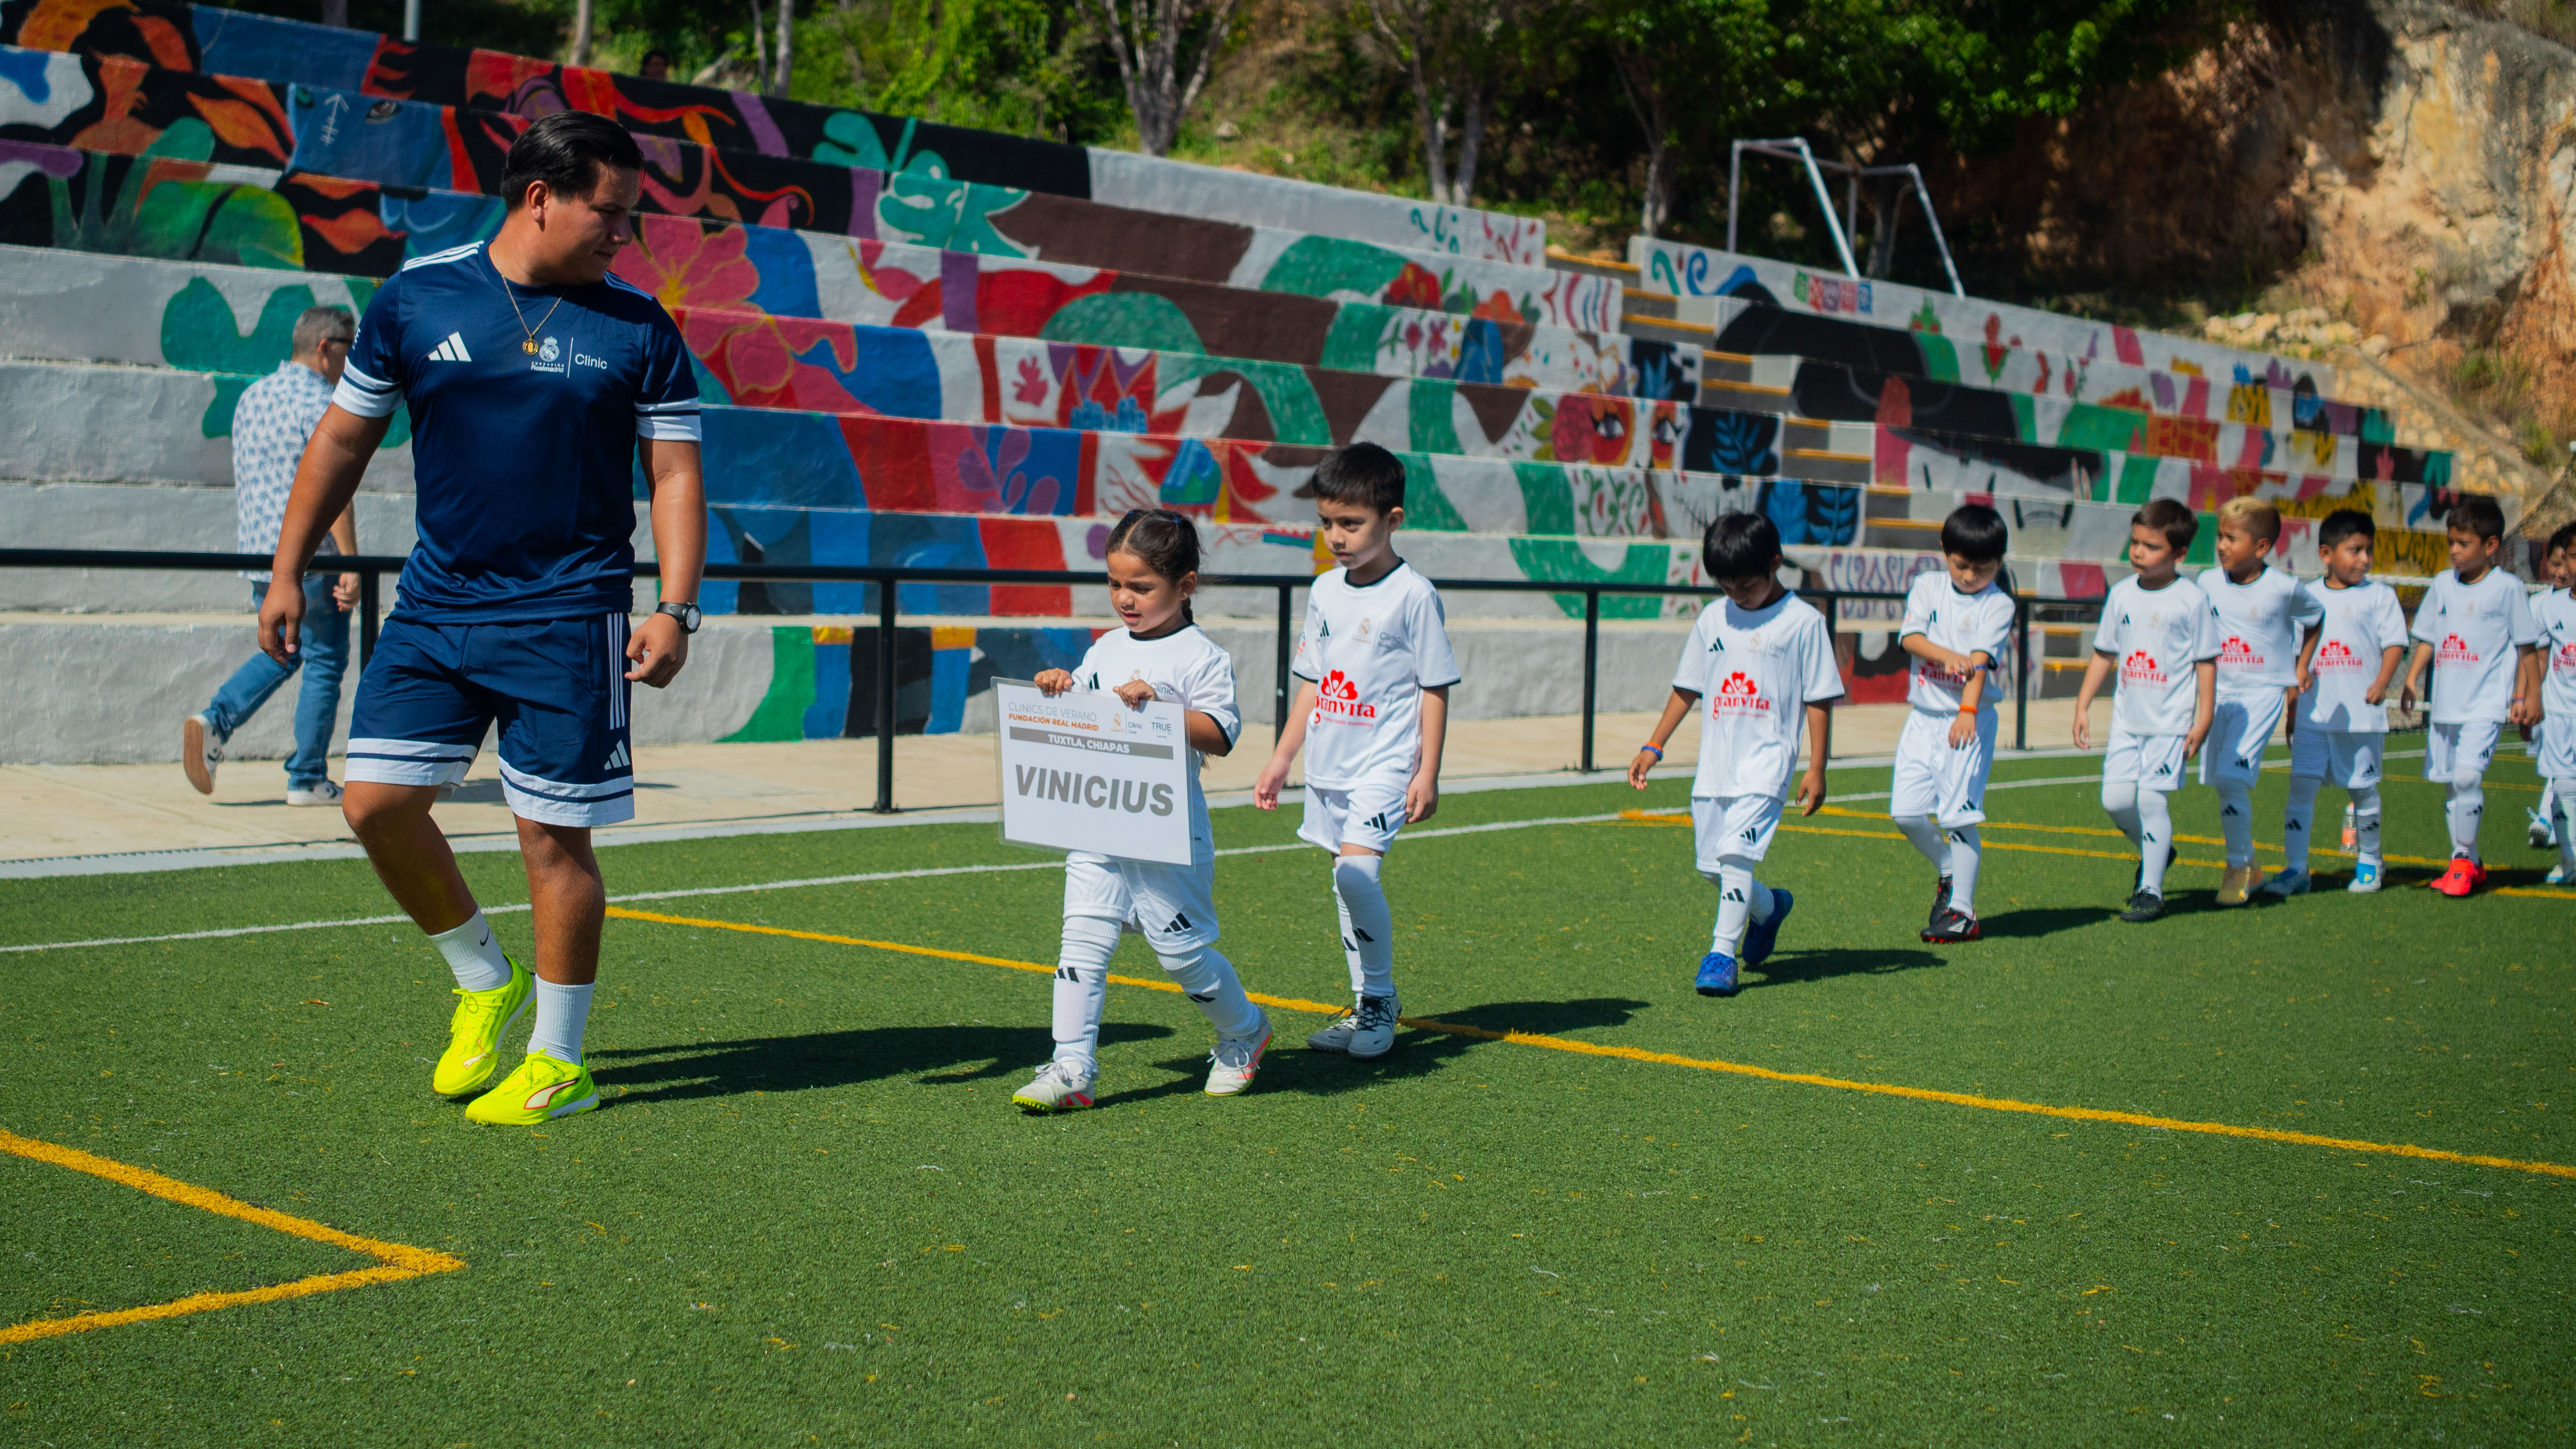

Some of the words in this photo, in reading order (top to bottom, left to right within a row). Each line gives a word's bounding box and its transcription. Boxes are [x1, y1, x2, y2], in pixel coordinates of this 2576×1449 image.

[575, 353, 607, 370] Clinic
[1150, 681, 1174, 695] Clinic
[1008, 702, 1043, 715] CLINICS
[1046, 706, 1058, 716] DE
[1060, 708, 1097, 722] VERANO
[1008, 713, 1050, 724] FUNDACIÓN
[1052, 718, 1070, 727] REAL
[1071, 721, 1099, 731] MADRID
[1151, 722, 1172, 732] TRUE
[1048, 734, 1085, 751] TUXTLA,
[1087, 740, 1130, 754] CHIAPAS
[1015, 764, 1174, 817] VINICIUS
